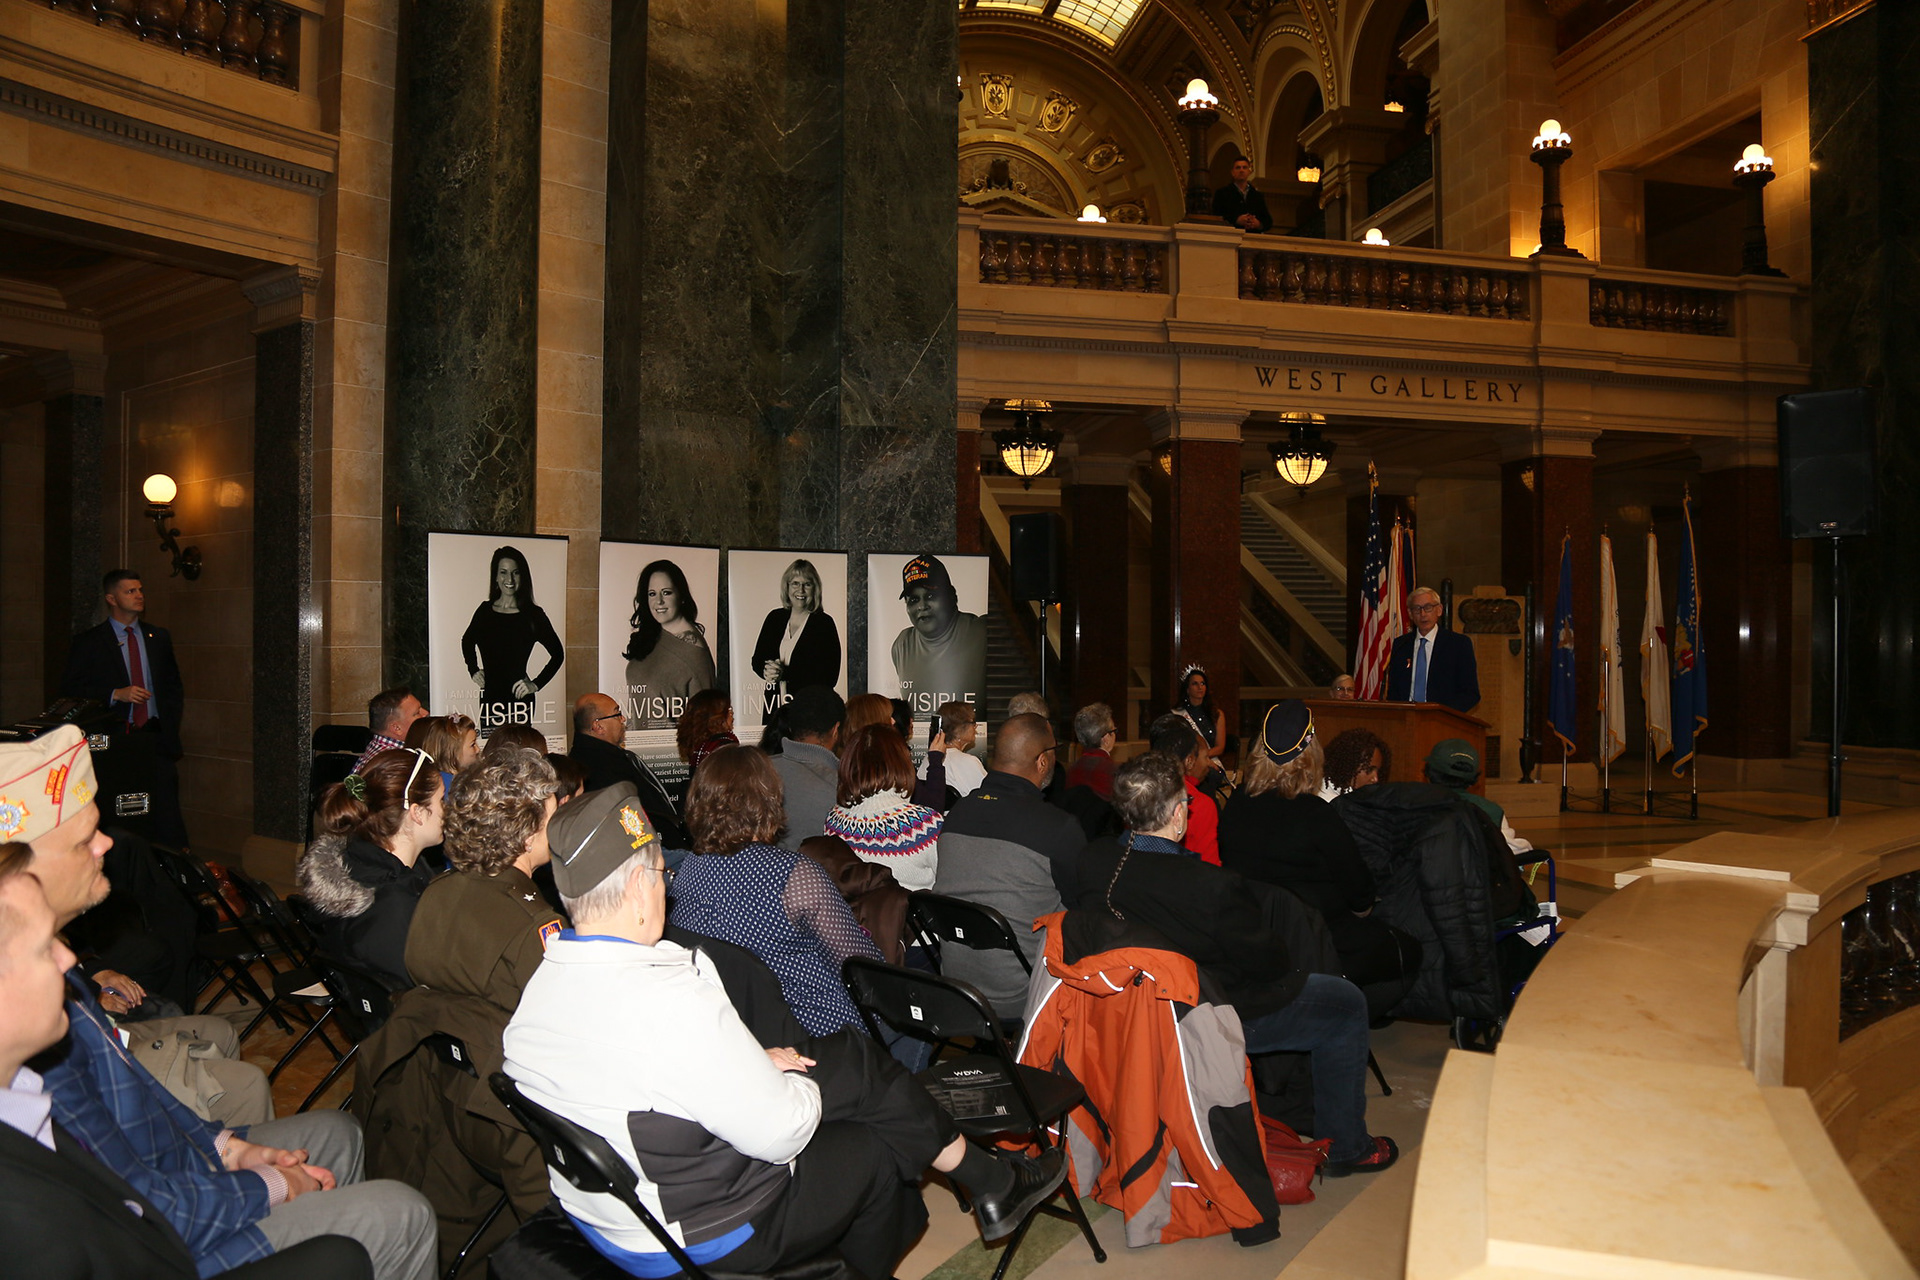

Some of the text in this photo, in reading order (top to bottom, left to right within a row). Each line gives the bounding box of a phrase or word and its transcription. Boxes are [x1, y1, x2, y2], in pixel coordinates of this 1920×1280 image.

[1254, 366, 1523, 403] WEST GALLERY
[631, 684, 647, 693] NOT
[760, 682, 777, 691] NOT
[898, 680, 914, 689] NOT
[450, 689, 465, 699] AM
[467, 688, 485, 699] NOT
[742, 693, 795, 715] INVIS
[900, 692, 977, 712] ISIBE
[618, 696, 690, 719] NVISIB
[672, 768, 690, 776] feeling
[953, 1069, 984, 1077] WDVA
